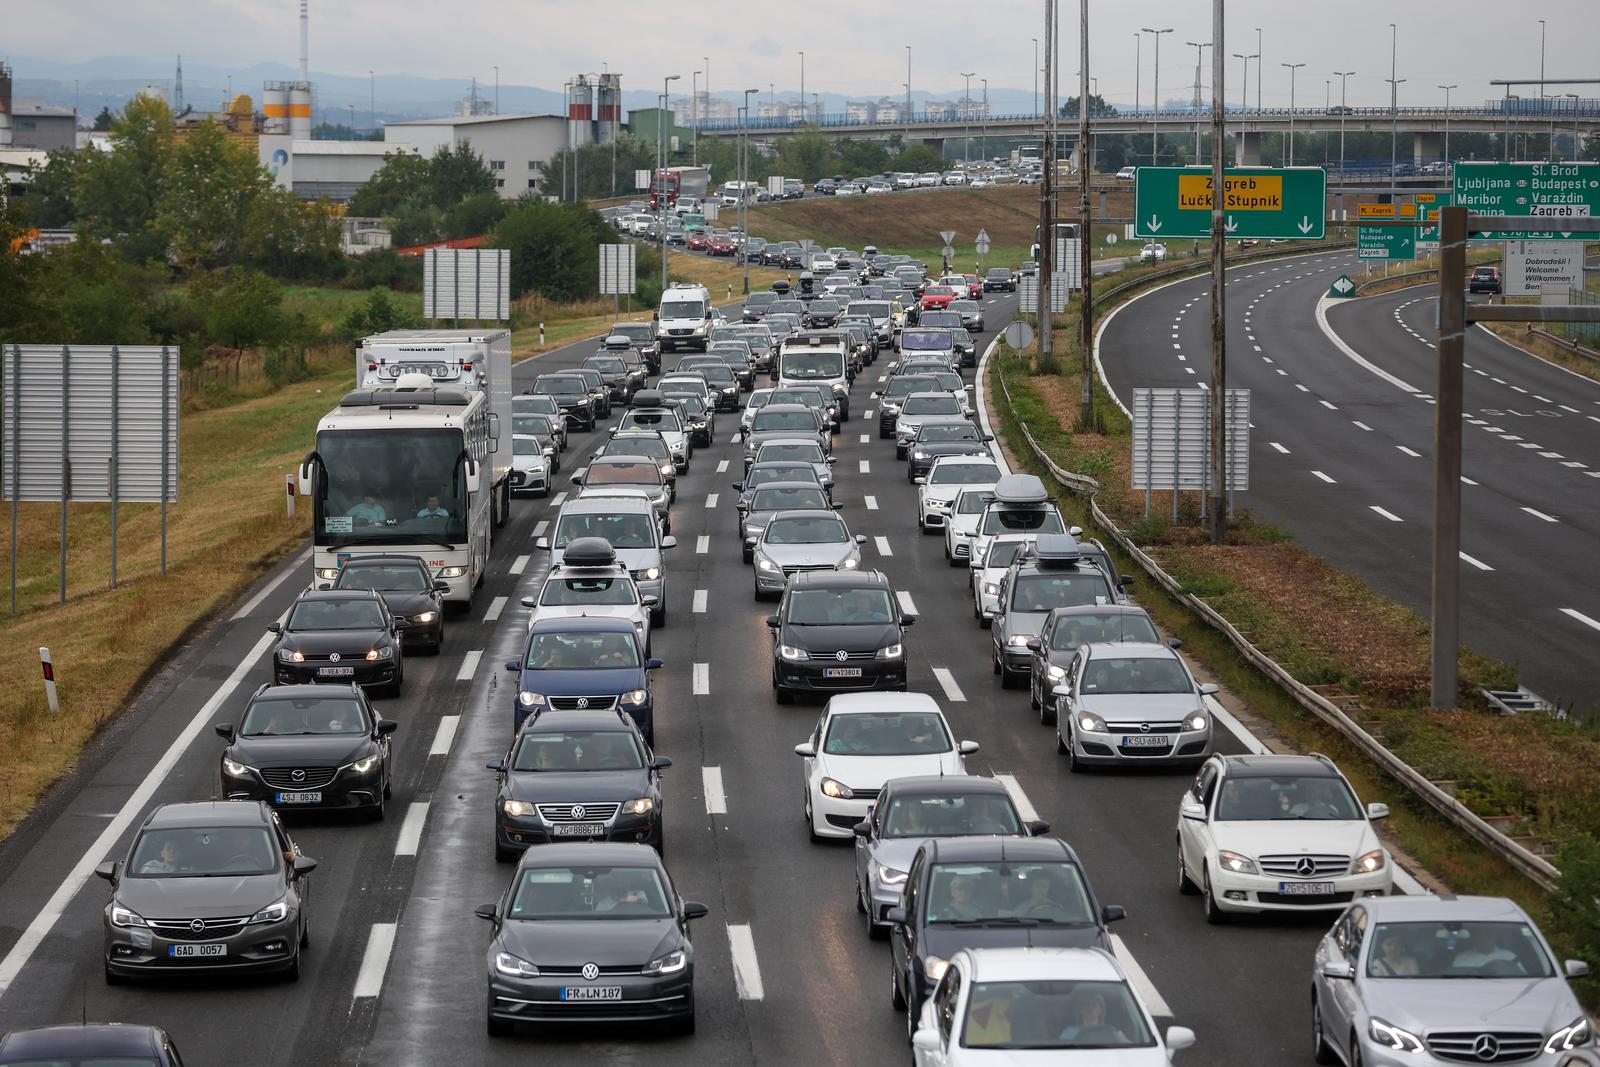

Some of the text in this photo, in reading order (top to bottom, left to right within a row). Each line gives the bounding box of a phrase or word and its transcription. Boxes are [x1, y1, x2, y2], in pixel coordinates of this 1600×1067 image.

[1532, 165, 1579, 176] Sl. Brod
[1206, 177, 1257, 192] Zgreb
[1457, 178, 1511, 191] Ljubljana
[1532, 178, 1587, 191] Budapest
[1181, 194, 1280, 208] Lučk-Stupnik
[1457, 194, 1502, 204] Maribor
[1532, 192, 1584, 203] Varaždin
[1531, 206, 1572, 216] Zagreb
[1128, 737, 1145, 745] KSU
[281, 793, 319, 801] 4SJ 0632
[176, 945, 222, 956] 6AD 0057
[567, 988, 621, 998] FR LN 187
